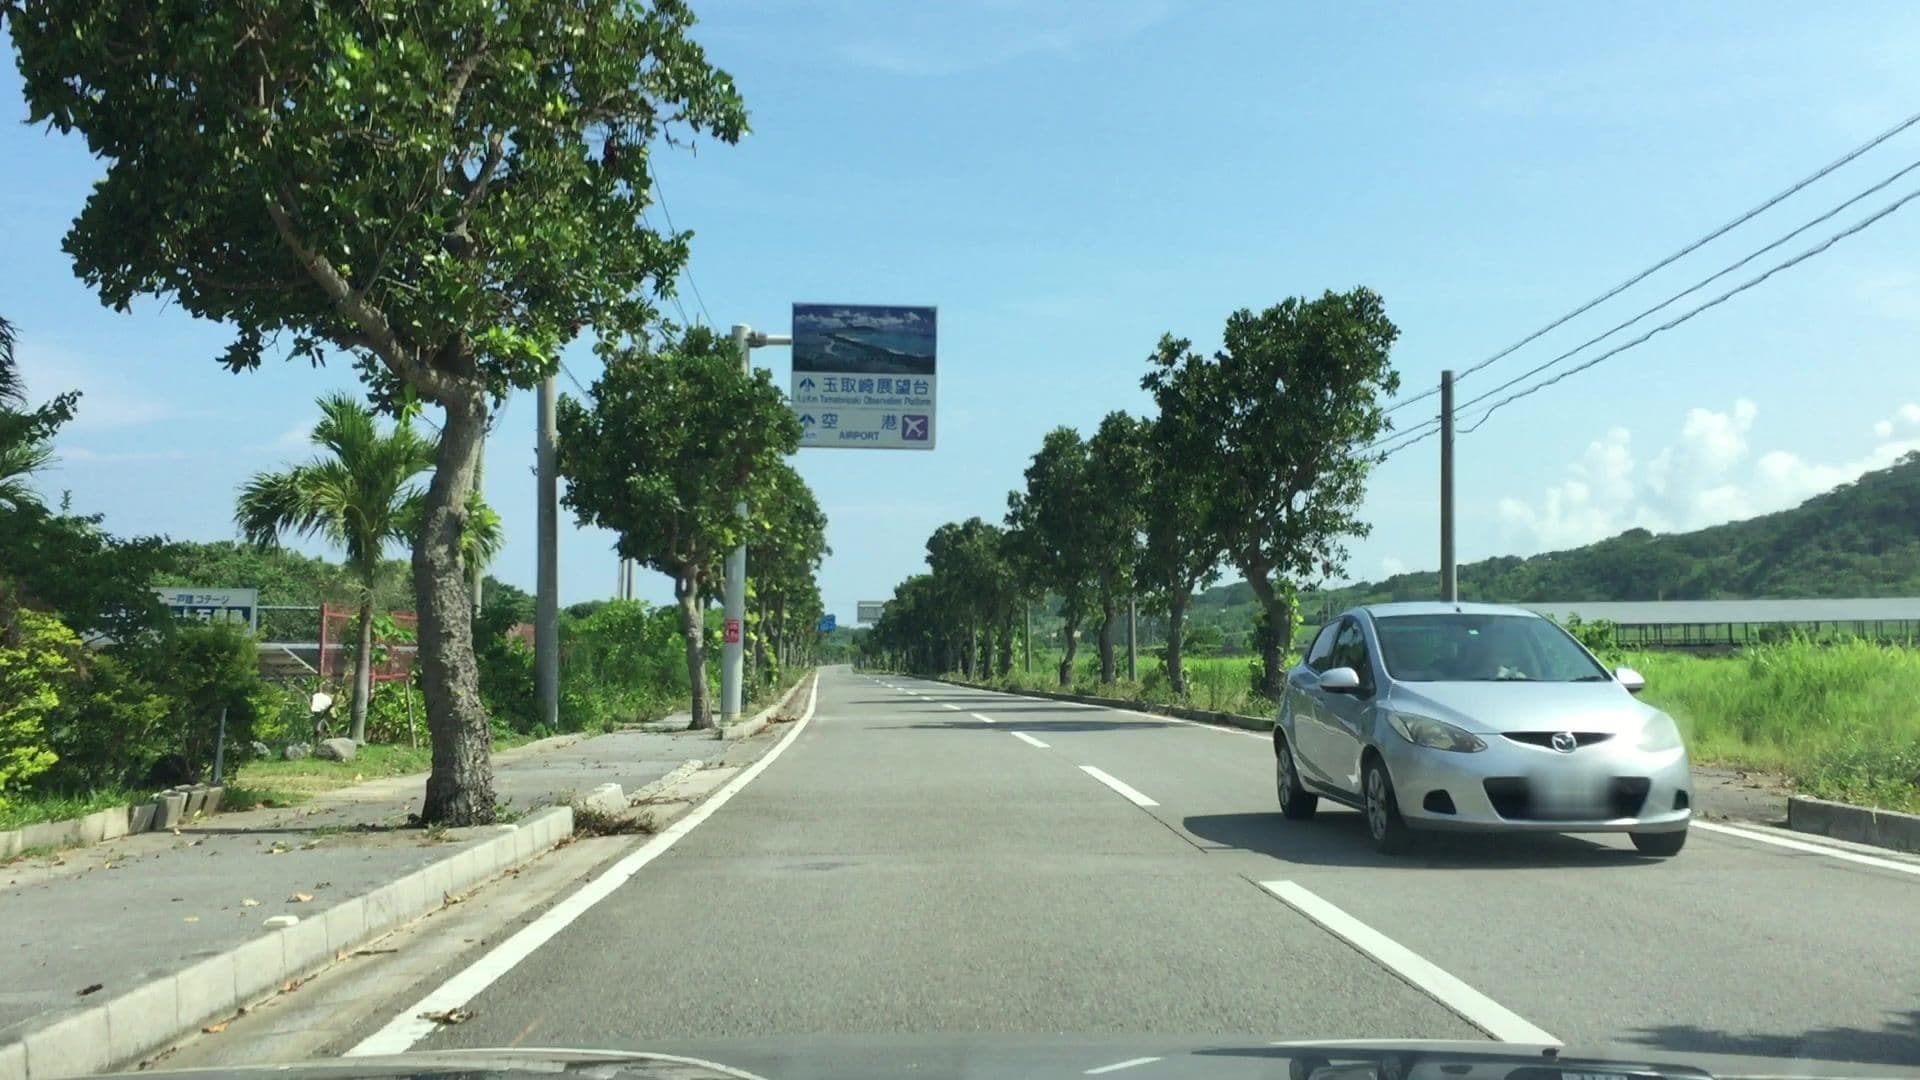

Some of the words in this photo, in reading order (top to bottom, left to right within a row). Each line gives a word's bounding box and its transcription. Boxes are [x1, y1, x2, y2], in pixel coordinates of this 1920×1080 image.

[823, 377, 929, 395] 玉取崎展望台
[839, 431, 880, 441] AIRPORT
